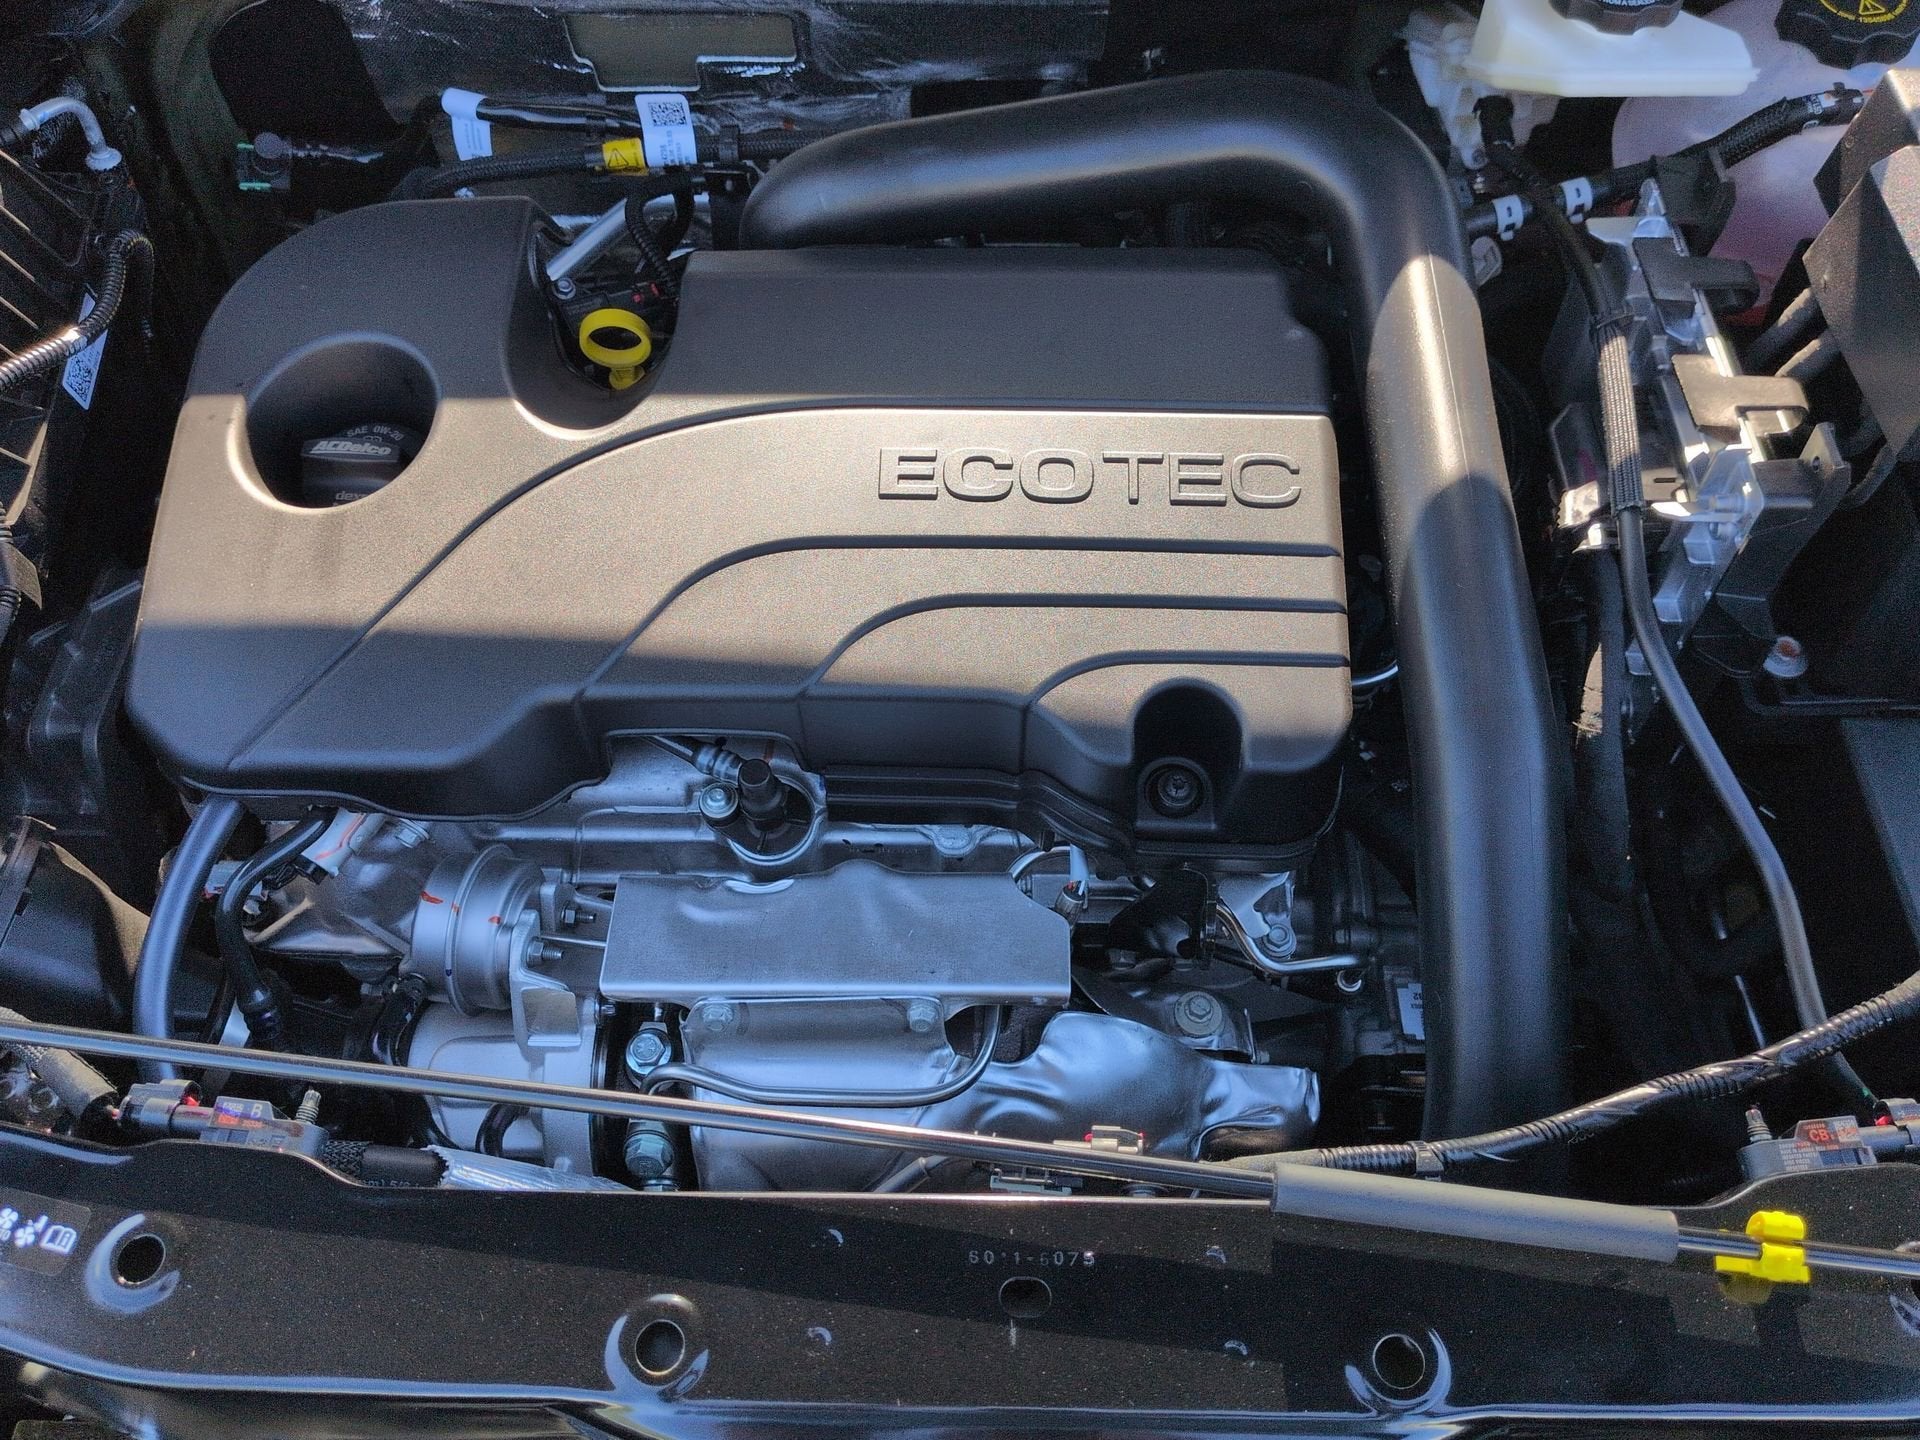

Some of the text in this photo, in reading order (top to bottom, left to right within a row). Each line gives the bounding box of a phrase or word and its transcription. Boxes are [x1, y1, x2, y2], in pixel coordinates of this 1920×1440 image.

[347, 425, 405, 441] SAE 0W-20
[309, 440, 392, 456] ACDelco
[878, 447, 1302, 509] ECOTEC
